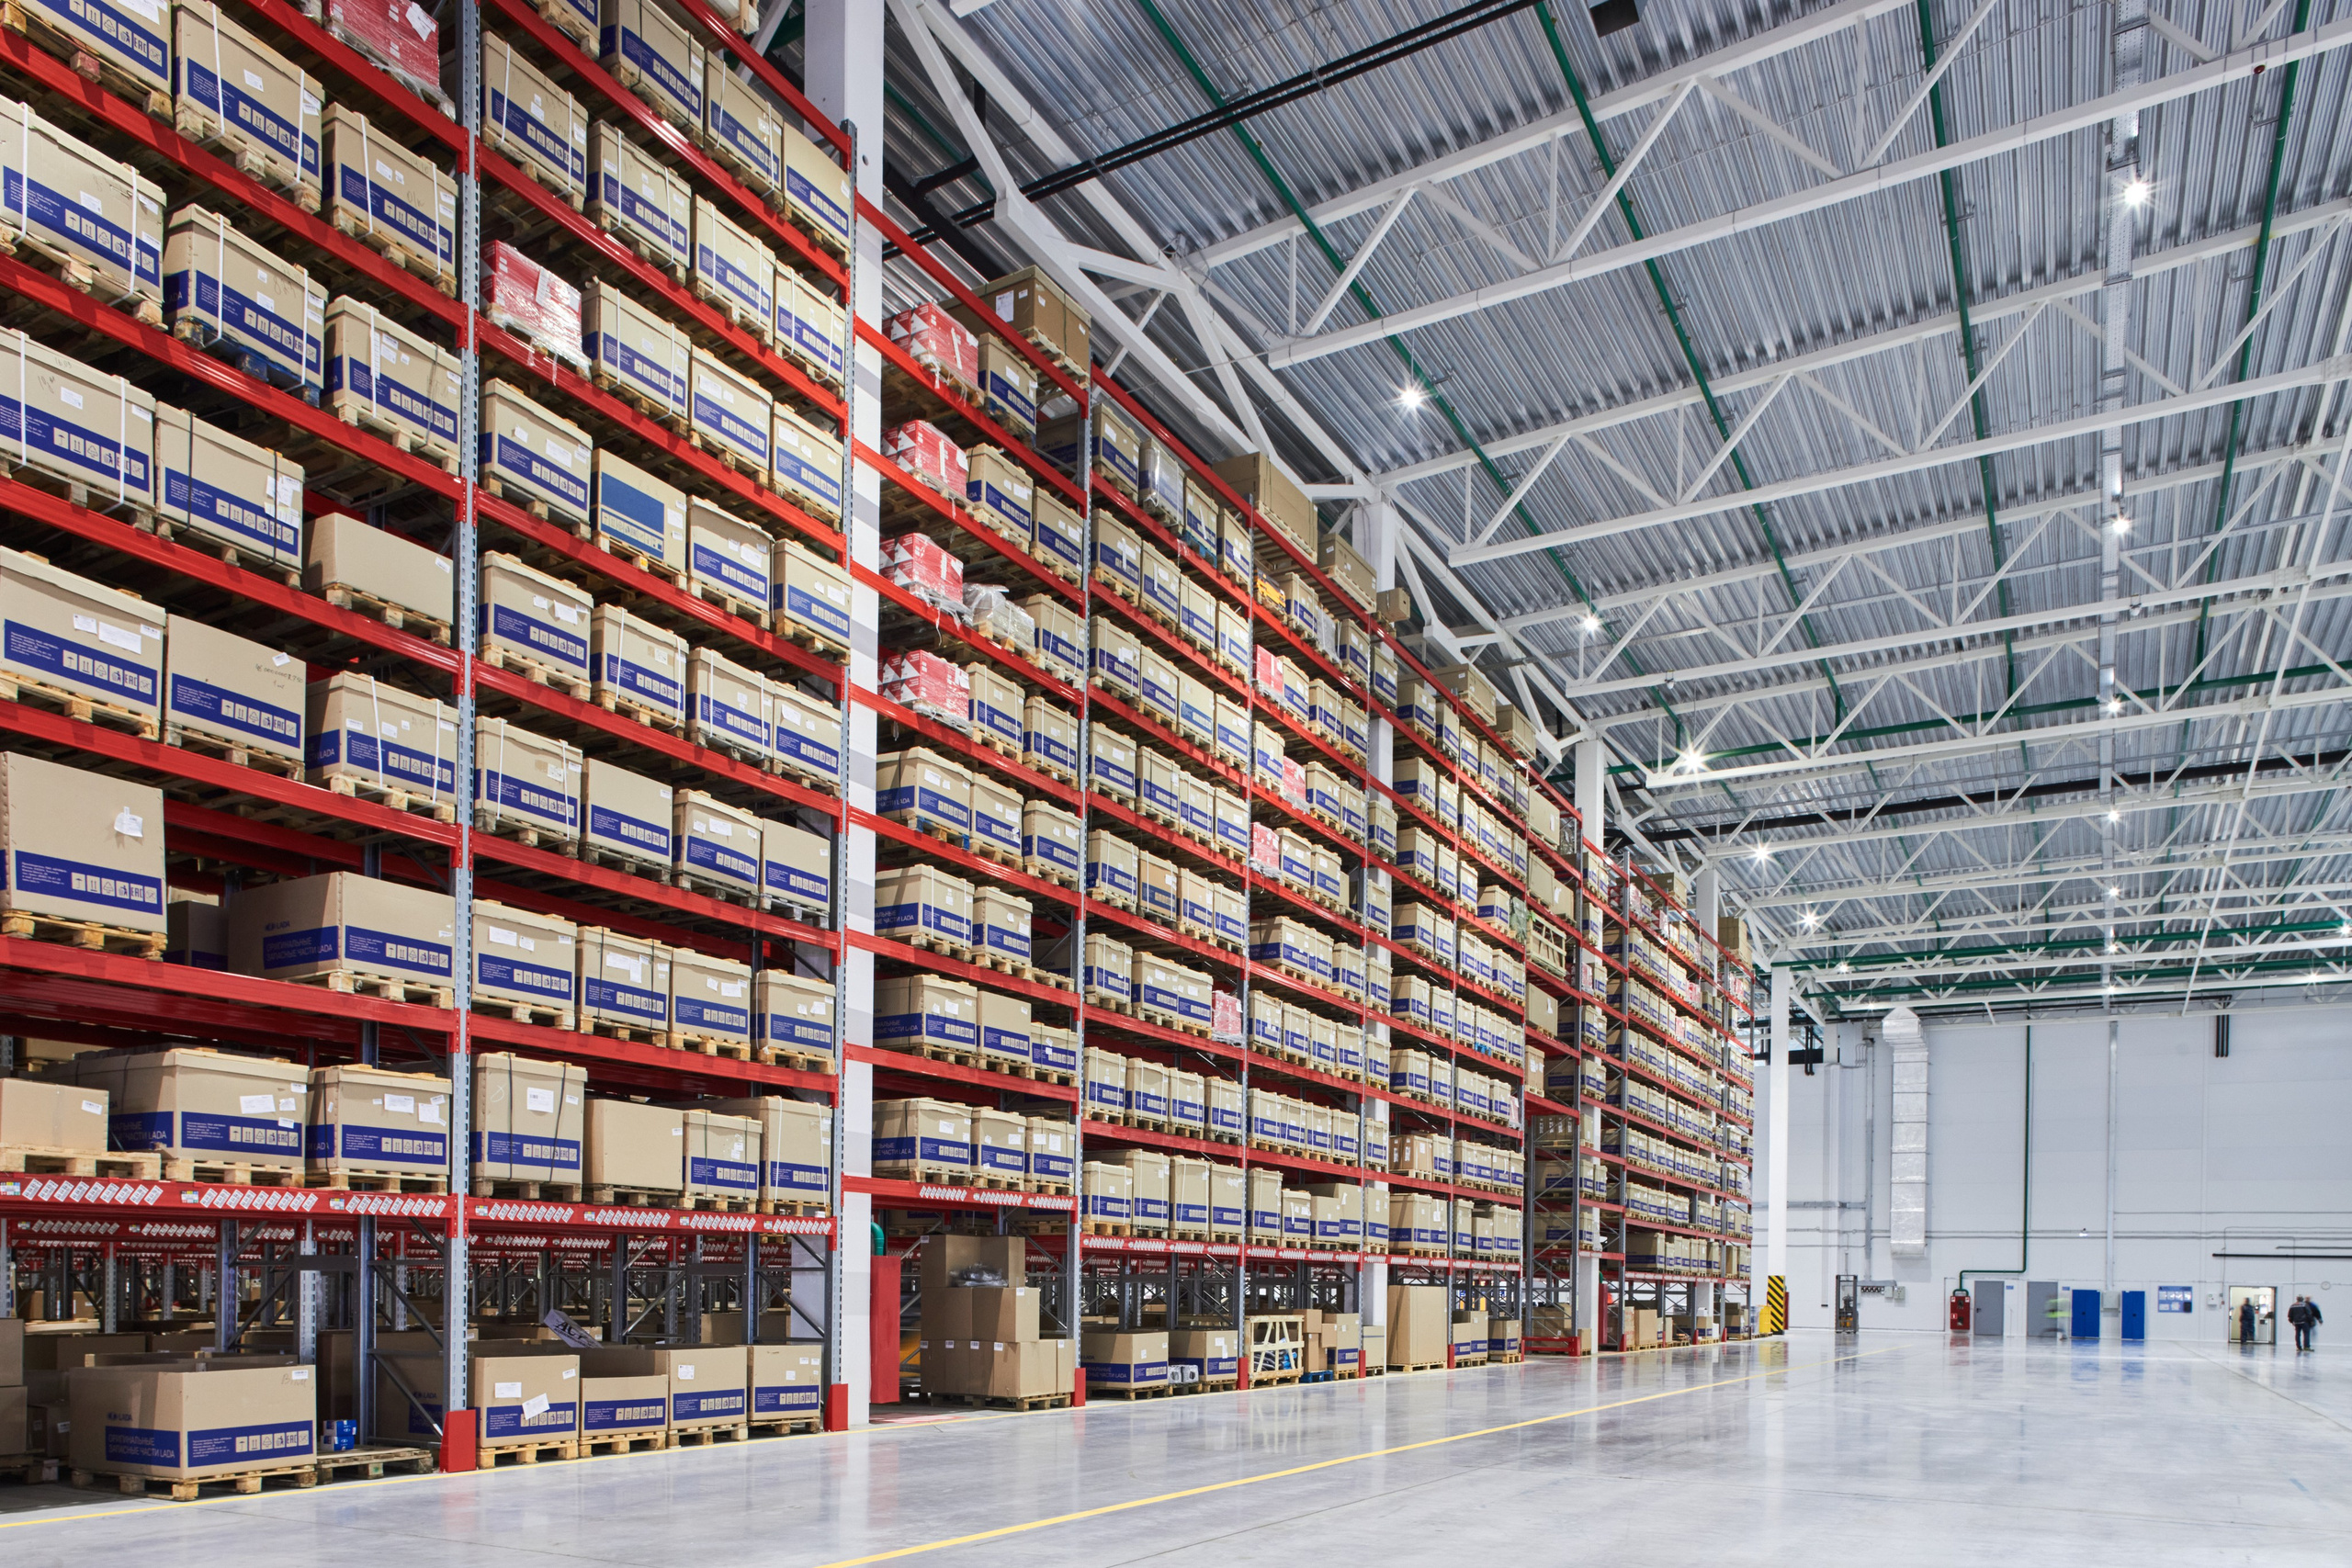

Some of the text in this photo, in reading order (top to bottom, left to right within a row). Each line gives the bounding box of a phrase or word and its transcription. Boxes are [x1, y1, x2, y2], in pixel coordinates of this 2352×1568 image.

[297, 946, 317, 957] ЧАСТИ
[317, 944, 334, 954] LADA
[147, 1129, 167, 1140] LADA
[140, 1447, 160, 1458] ЧАСТИ
[159, 1448, 175, 1460] LADA
